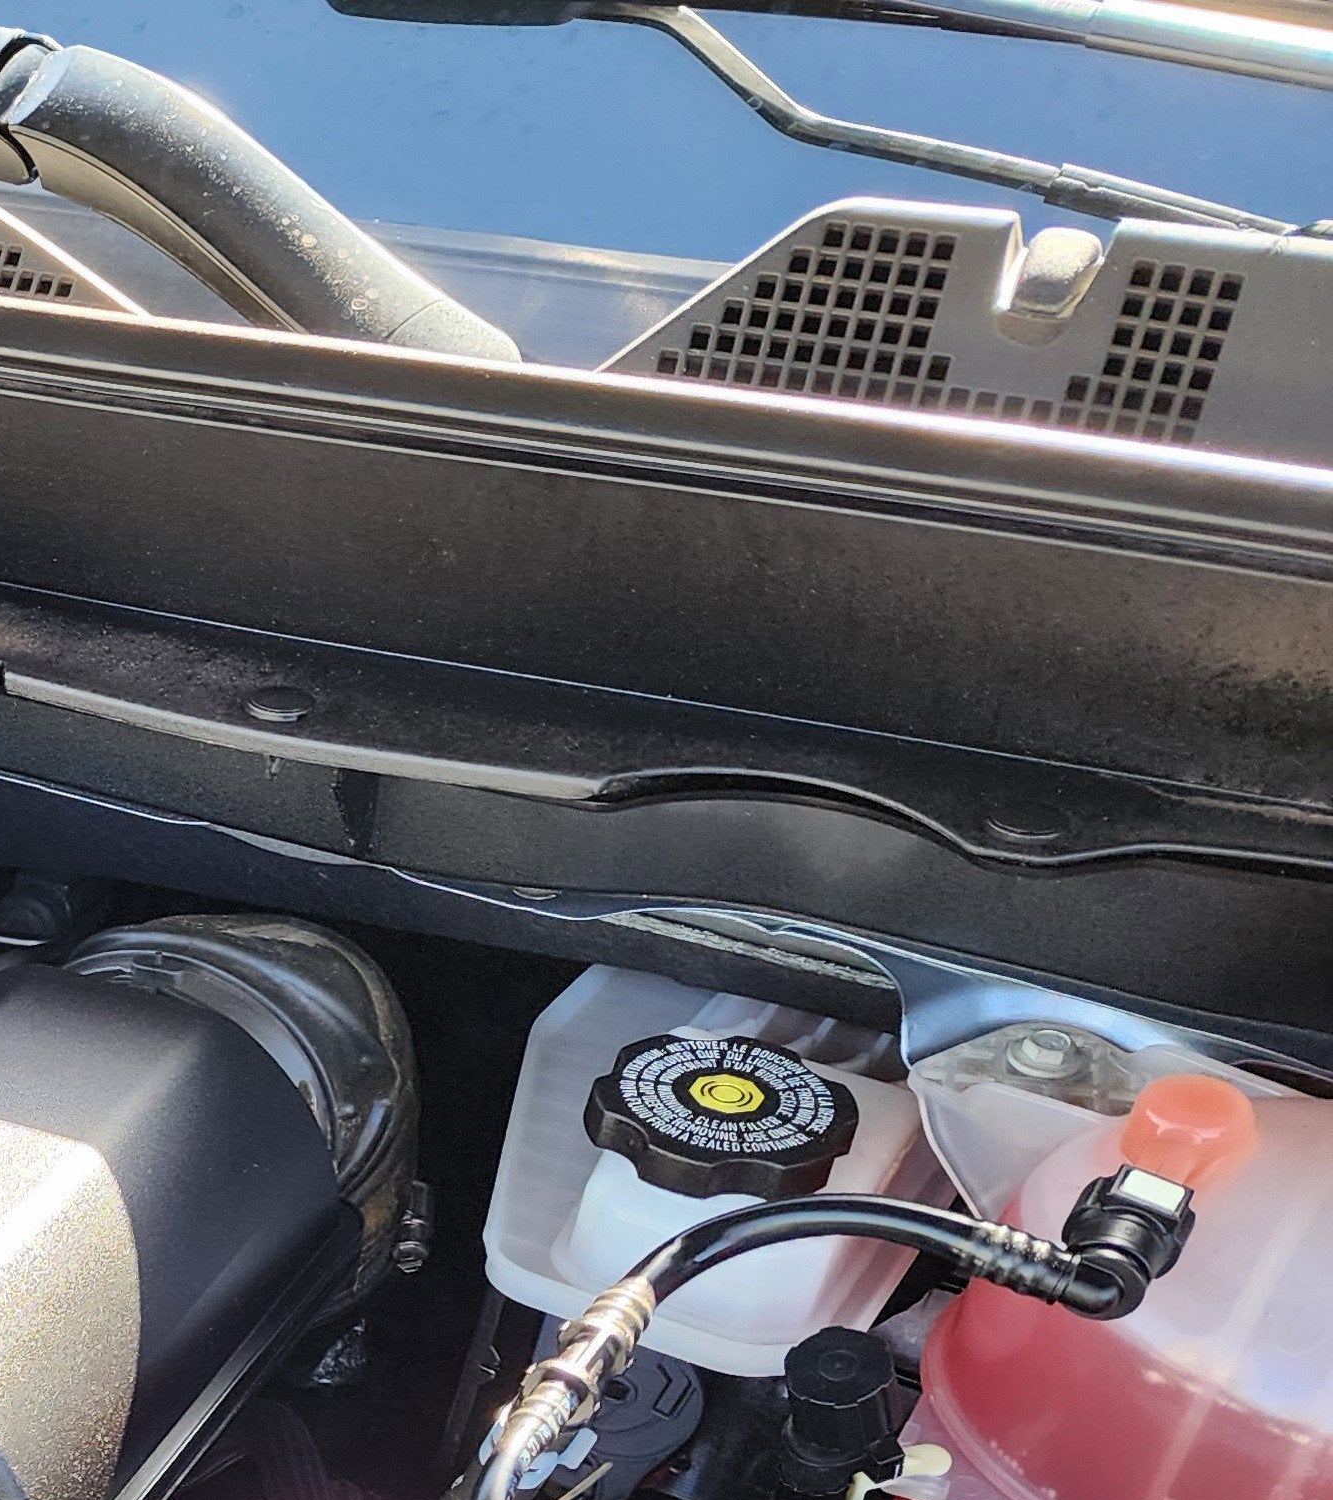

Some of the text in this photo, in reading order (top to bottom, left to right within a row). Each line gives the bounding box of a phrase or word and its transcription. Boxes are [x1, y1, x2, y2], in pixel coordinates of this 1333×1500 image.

[666, 1040, 729, 1053] NETTOYER
[733, 1043, 748, 1054] LE
[750, 1047, 808, 1075] BOUCHON
[799, 1074, 831, 1095] AVANT
[695, 1049, 721, 1059] QUE
[726, 1050, 743, 1061] DU
[745, 1055, 793, 1078] LIQUIDE
[723, 1059, 754, 1073] D'UN
[754, 1069, 788, 1091] BIDON
[622, 1097, 654, 1119] FLUID
[646, 1116, 683, 1137] FROM
[677, 1131, 690, 1142] A
[690, 1134, 741, 1152] SEALED
[641, 1095, 677, 1122] BEFORE
[743, 1130, 770, 1142] USE
[767, 1123, 799, 1139] ONLY
[694, 1115, 738, 1132] CLEAN
[739, 1115, 783, 1132] FILLER
